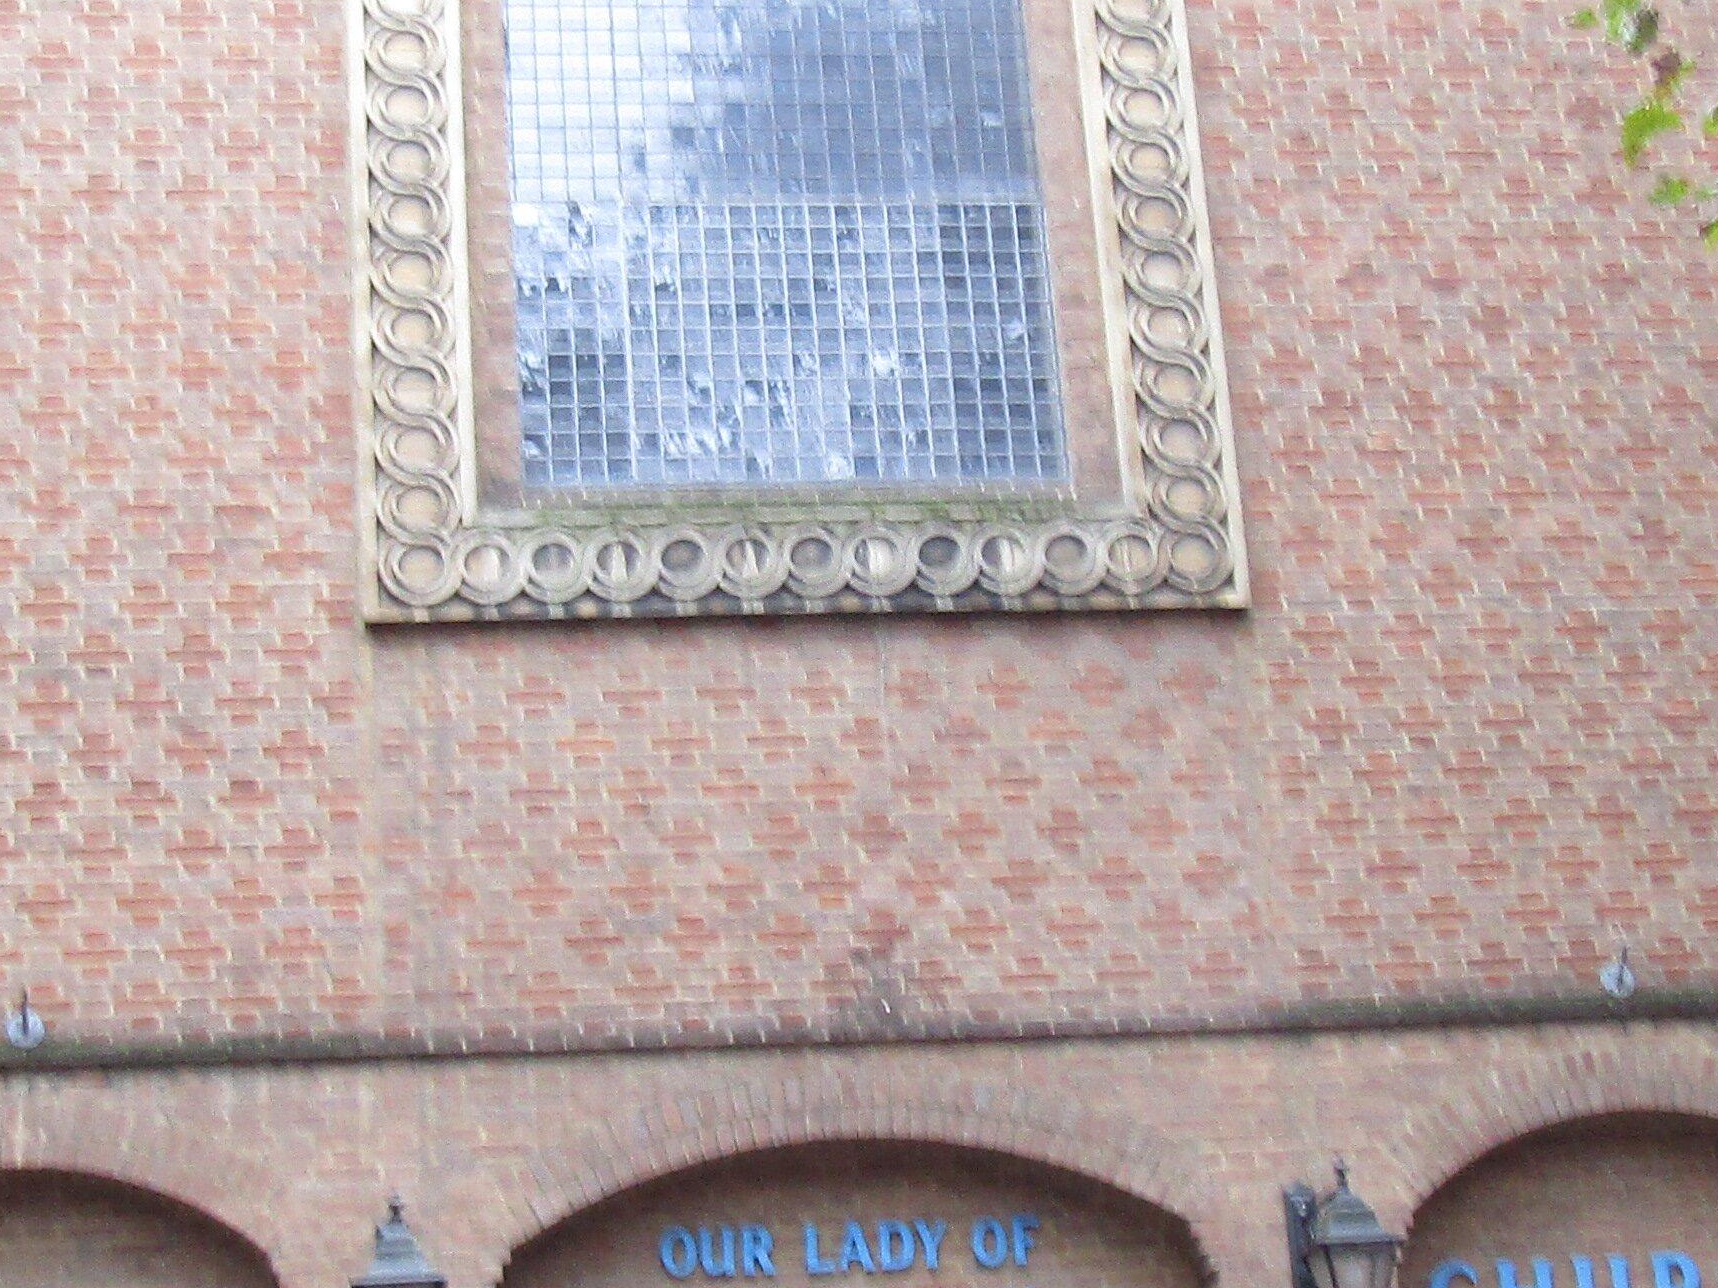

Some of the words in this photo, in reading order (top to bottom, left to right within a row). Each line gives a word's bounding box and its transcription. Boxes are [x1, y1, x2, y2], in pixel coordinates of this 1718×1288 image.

[659, 1224, 777, 1280] OUR
[804, 1218, 947, 1276] LADY
[970, 1213, 1040, 1269] OF
